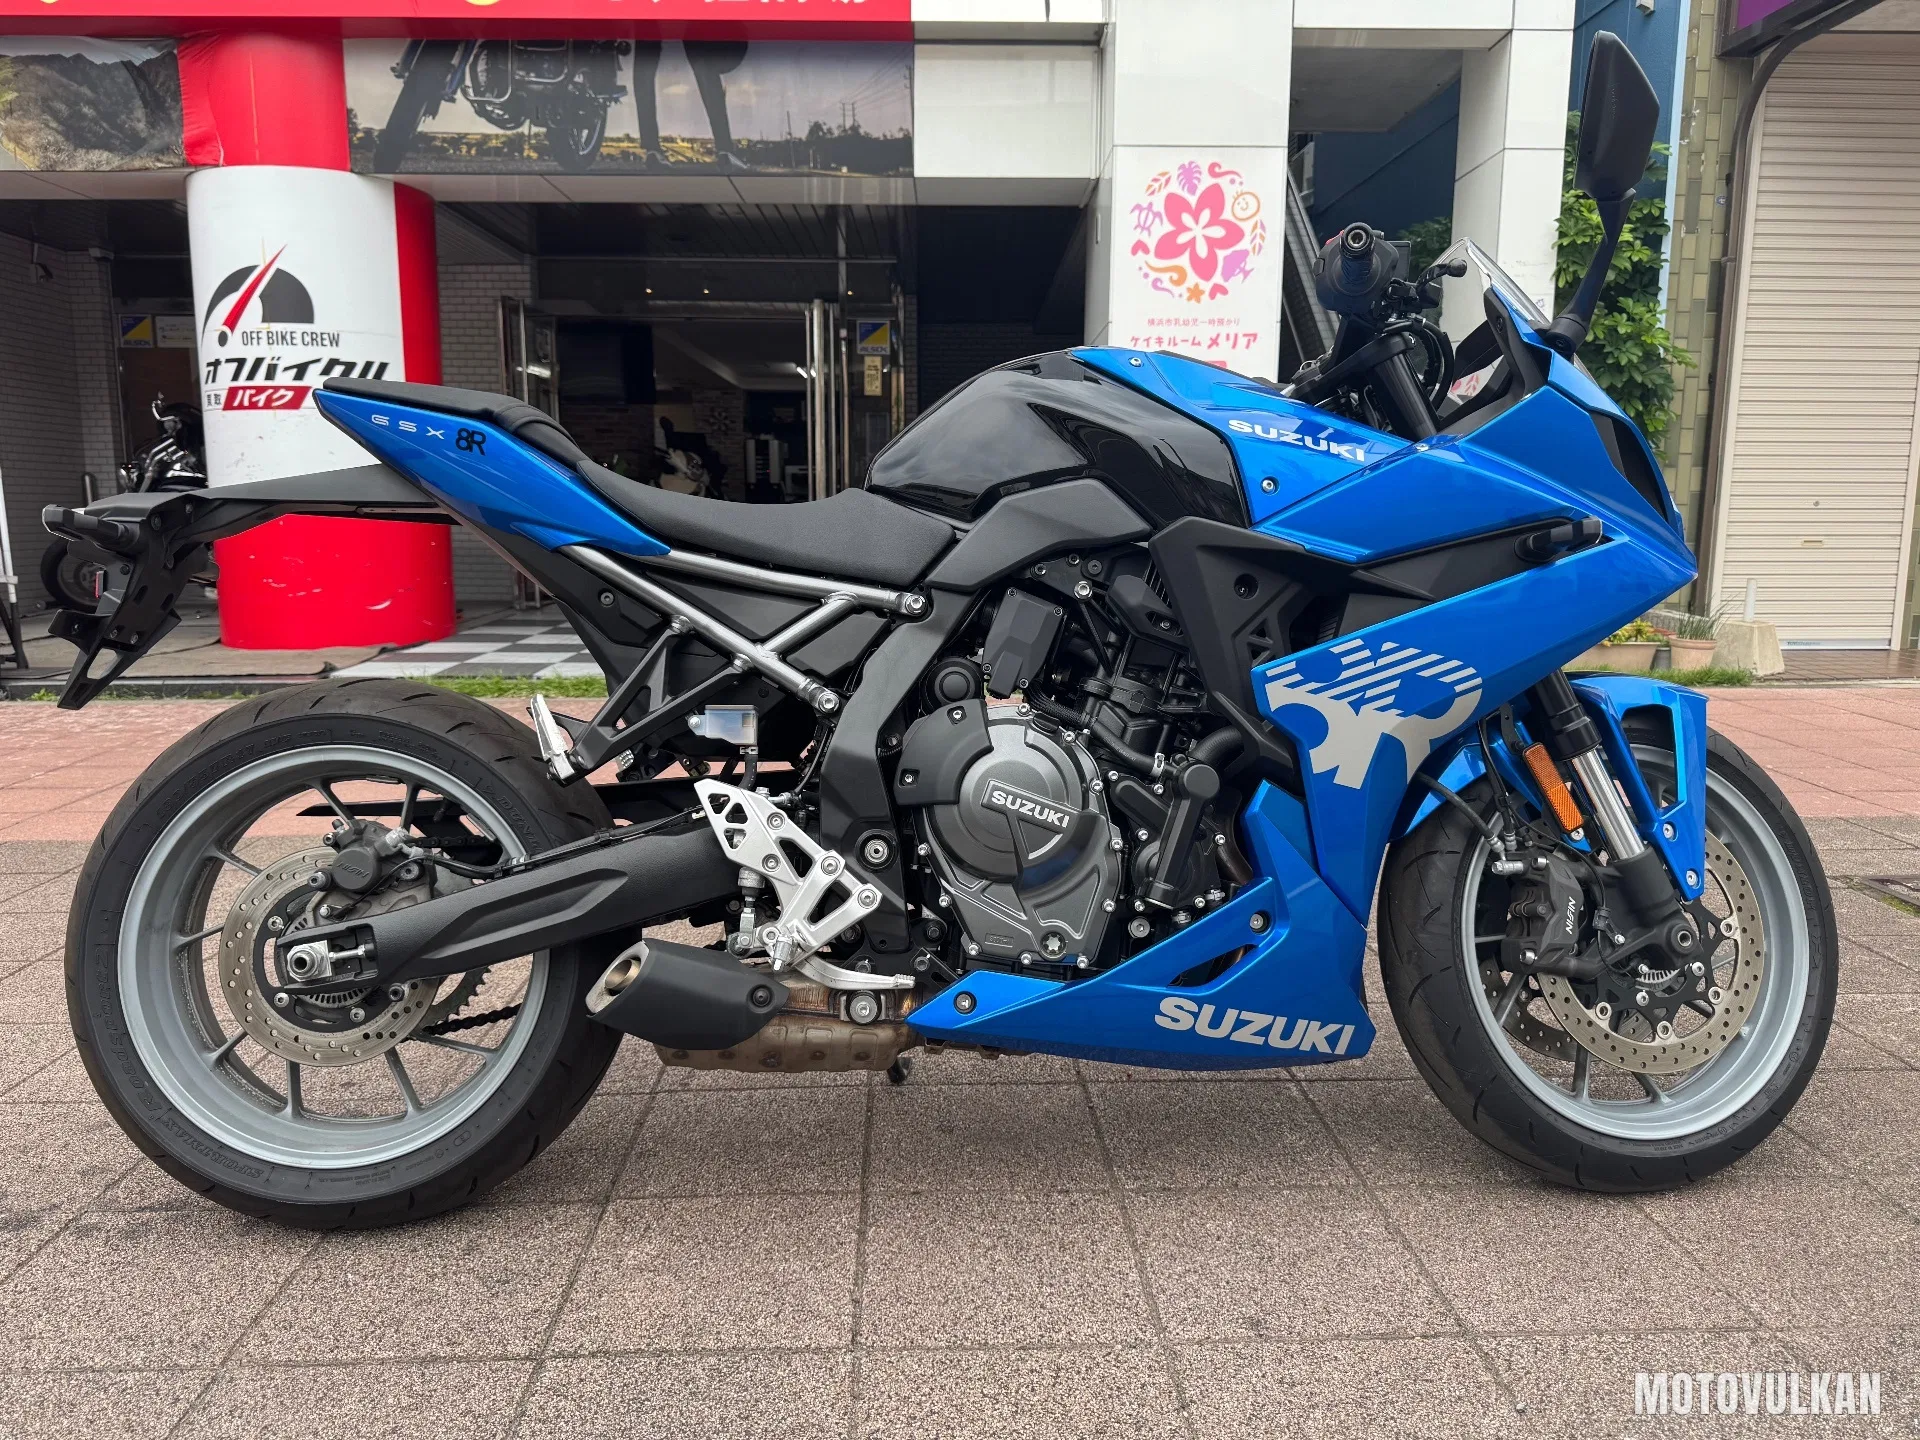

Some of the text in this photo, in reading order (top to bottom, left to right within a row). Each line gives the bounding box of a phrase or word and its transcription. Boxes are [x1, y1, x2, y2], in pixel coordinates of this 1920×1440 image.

[241, 331, 340, 347] OFF BIKE CREW
[1130, 333, 1258, 350] ケイキルーム メリア
[232, 388, 295, 407] バイク
[455, 427, 487, 456] 8R
[1228, 419, 1365, 462] SUZUKI
[991, 790, 1070, 828] SUZUKI
[1154, 996, 1356, 1055] SUZUKI
